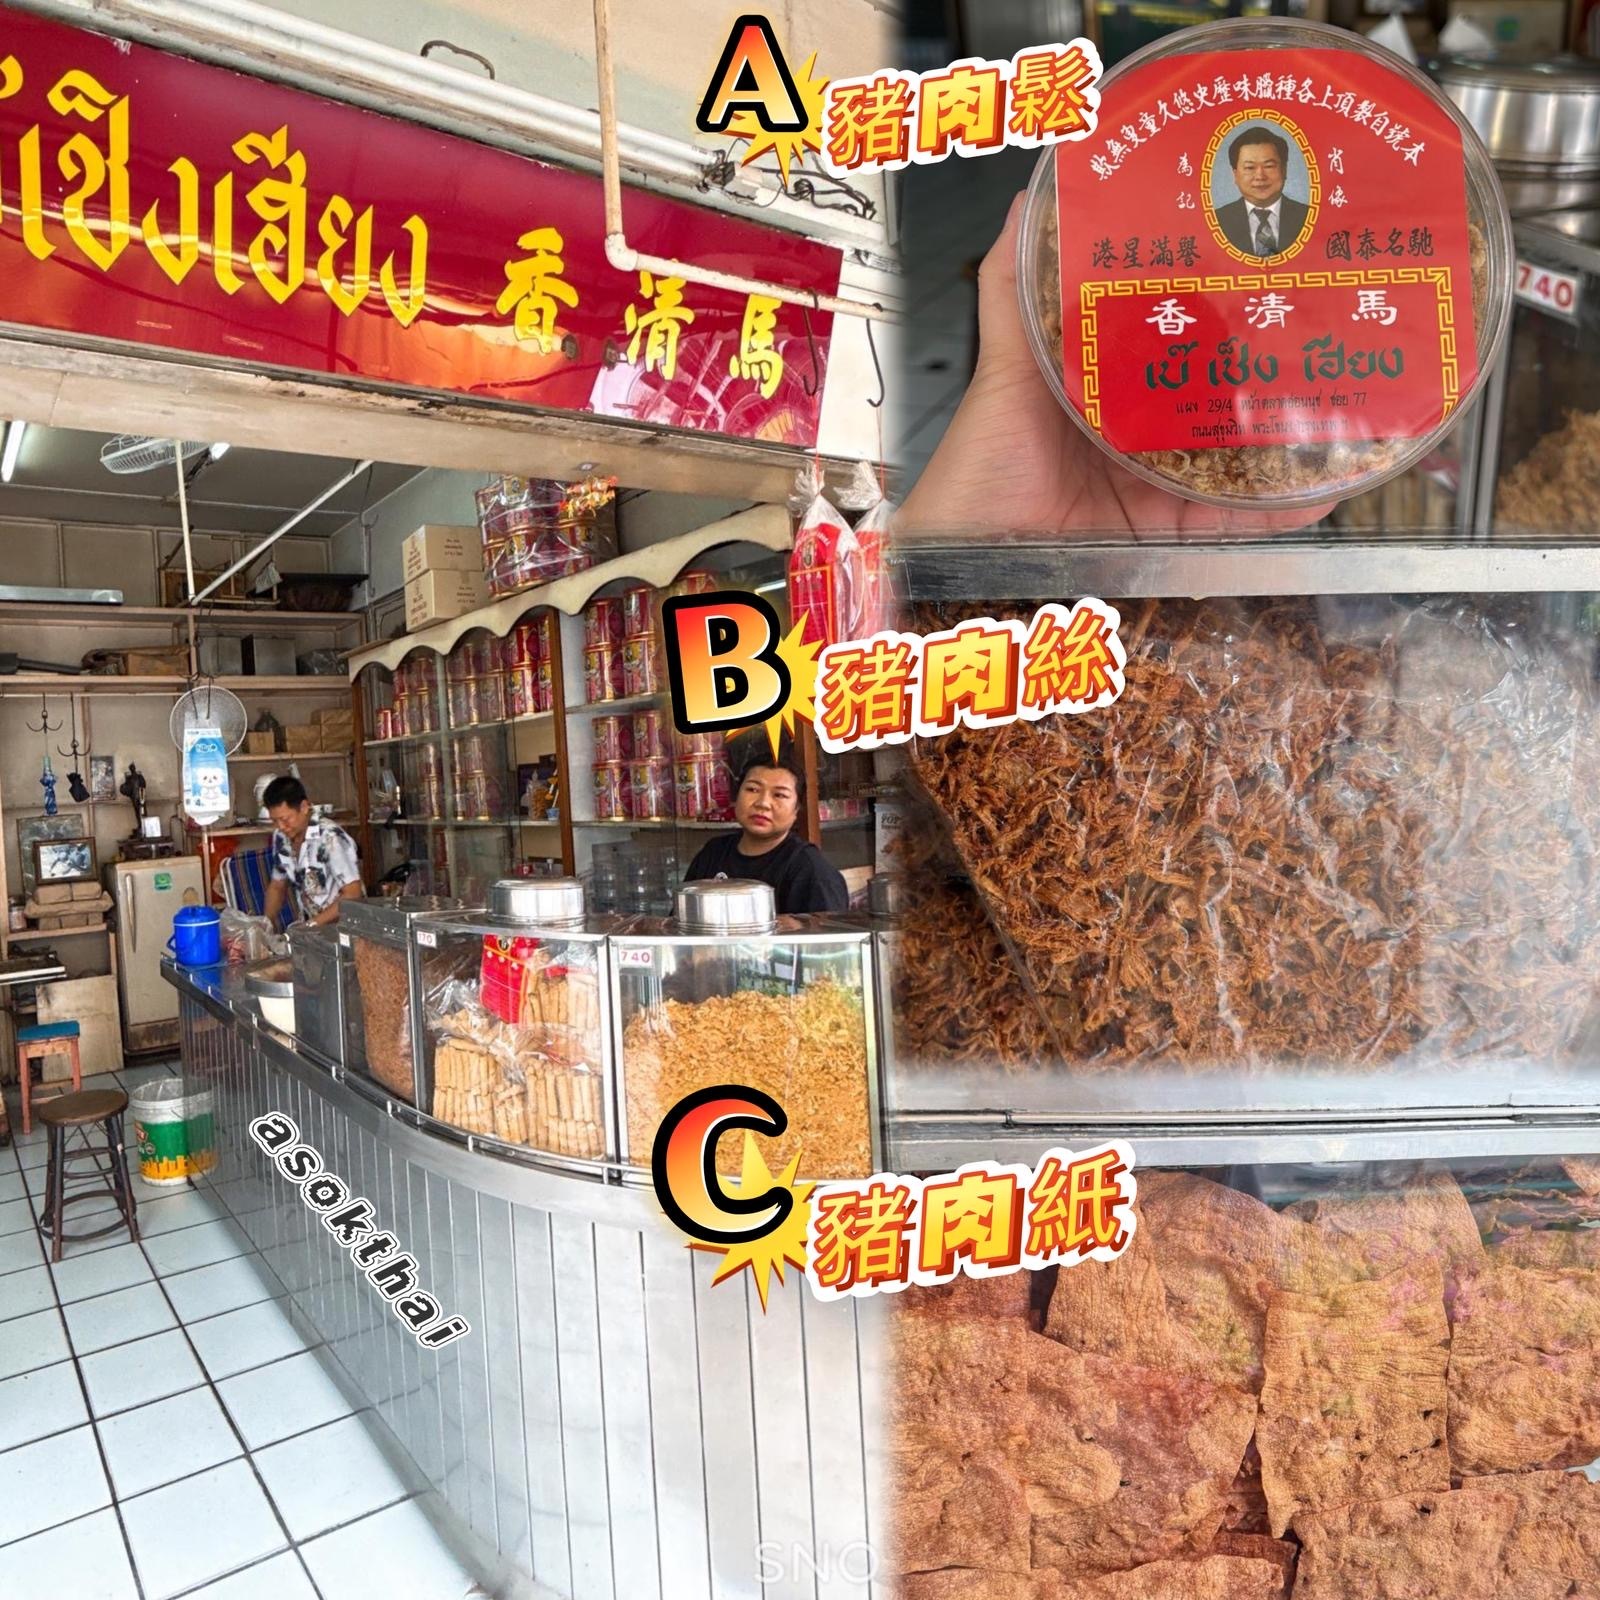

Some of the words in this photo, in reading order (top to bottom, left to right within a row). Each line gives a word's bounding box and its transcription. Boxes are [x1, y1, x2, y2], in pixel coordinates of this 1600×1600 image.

[1519, 264, 1573, 309] 740
[1207, 398, 1233, 414] 29/4
[1353, 392, 1368, 407] 77
[621, 951, 651, 964] 740
